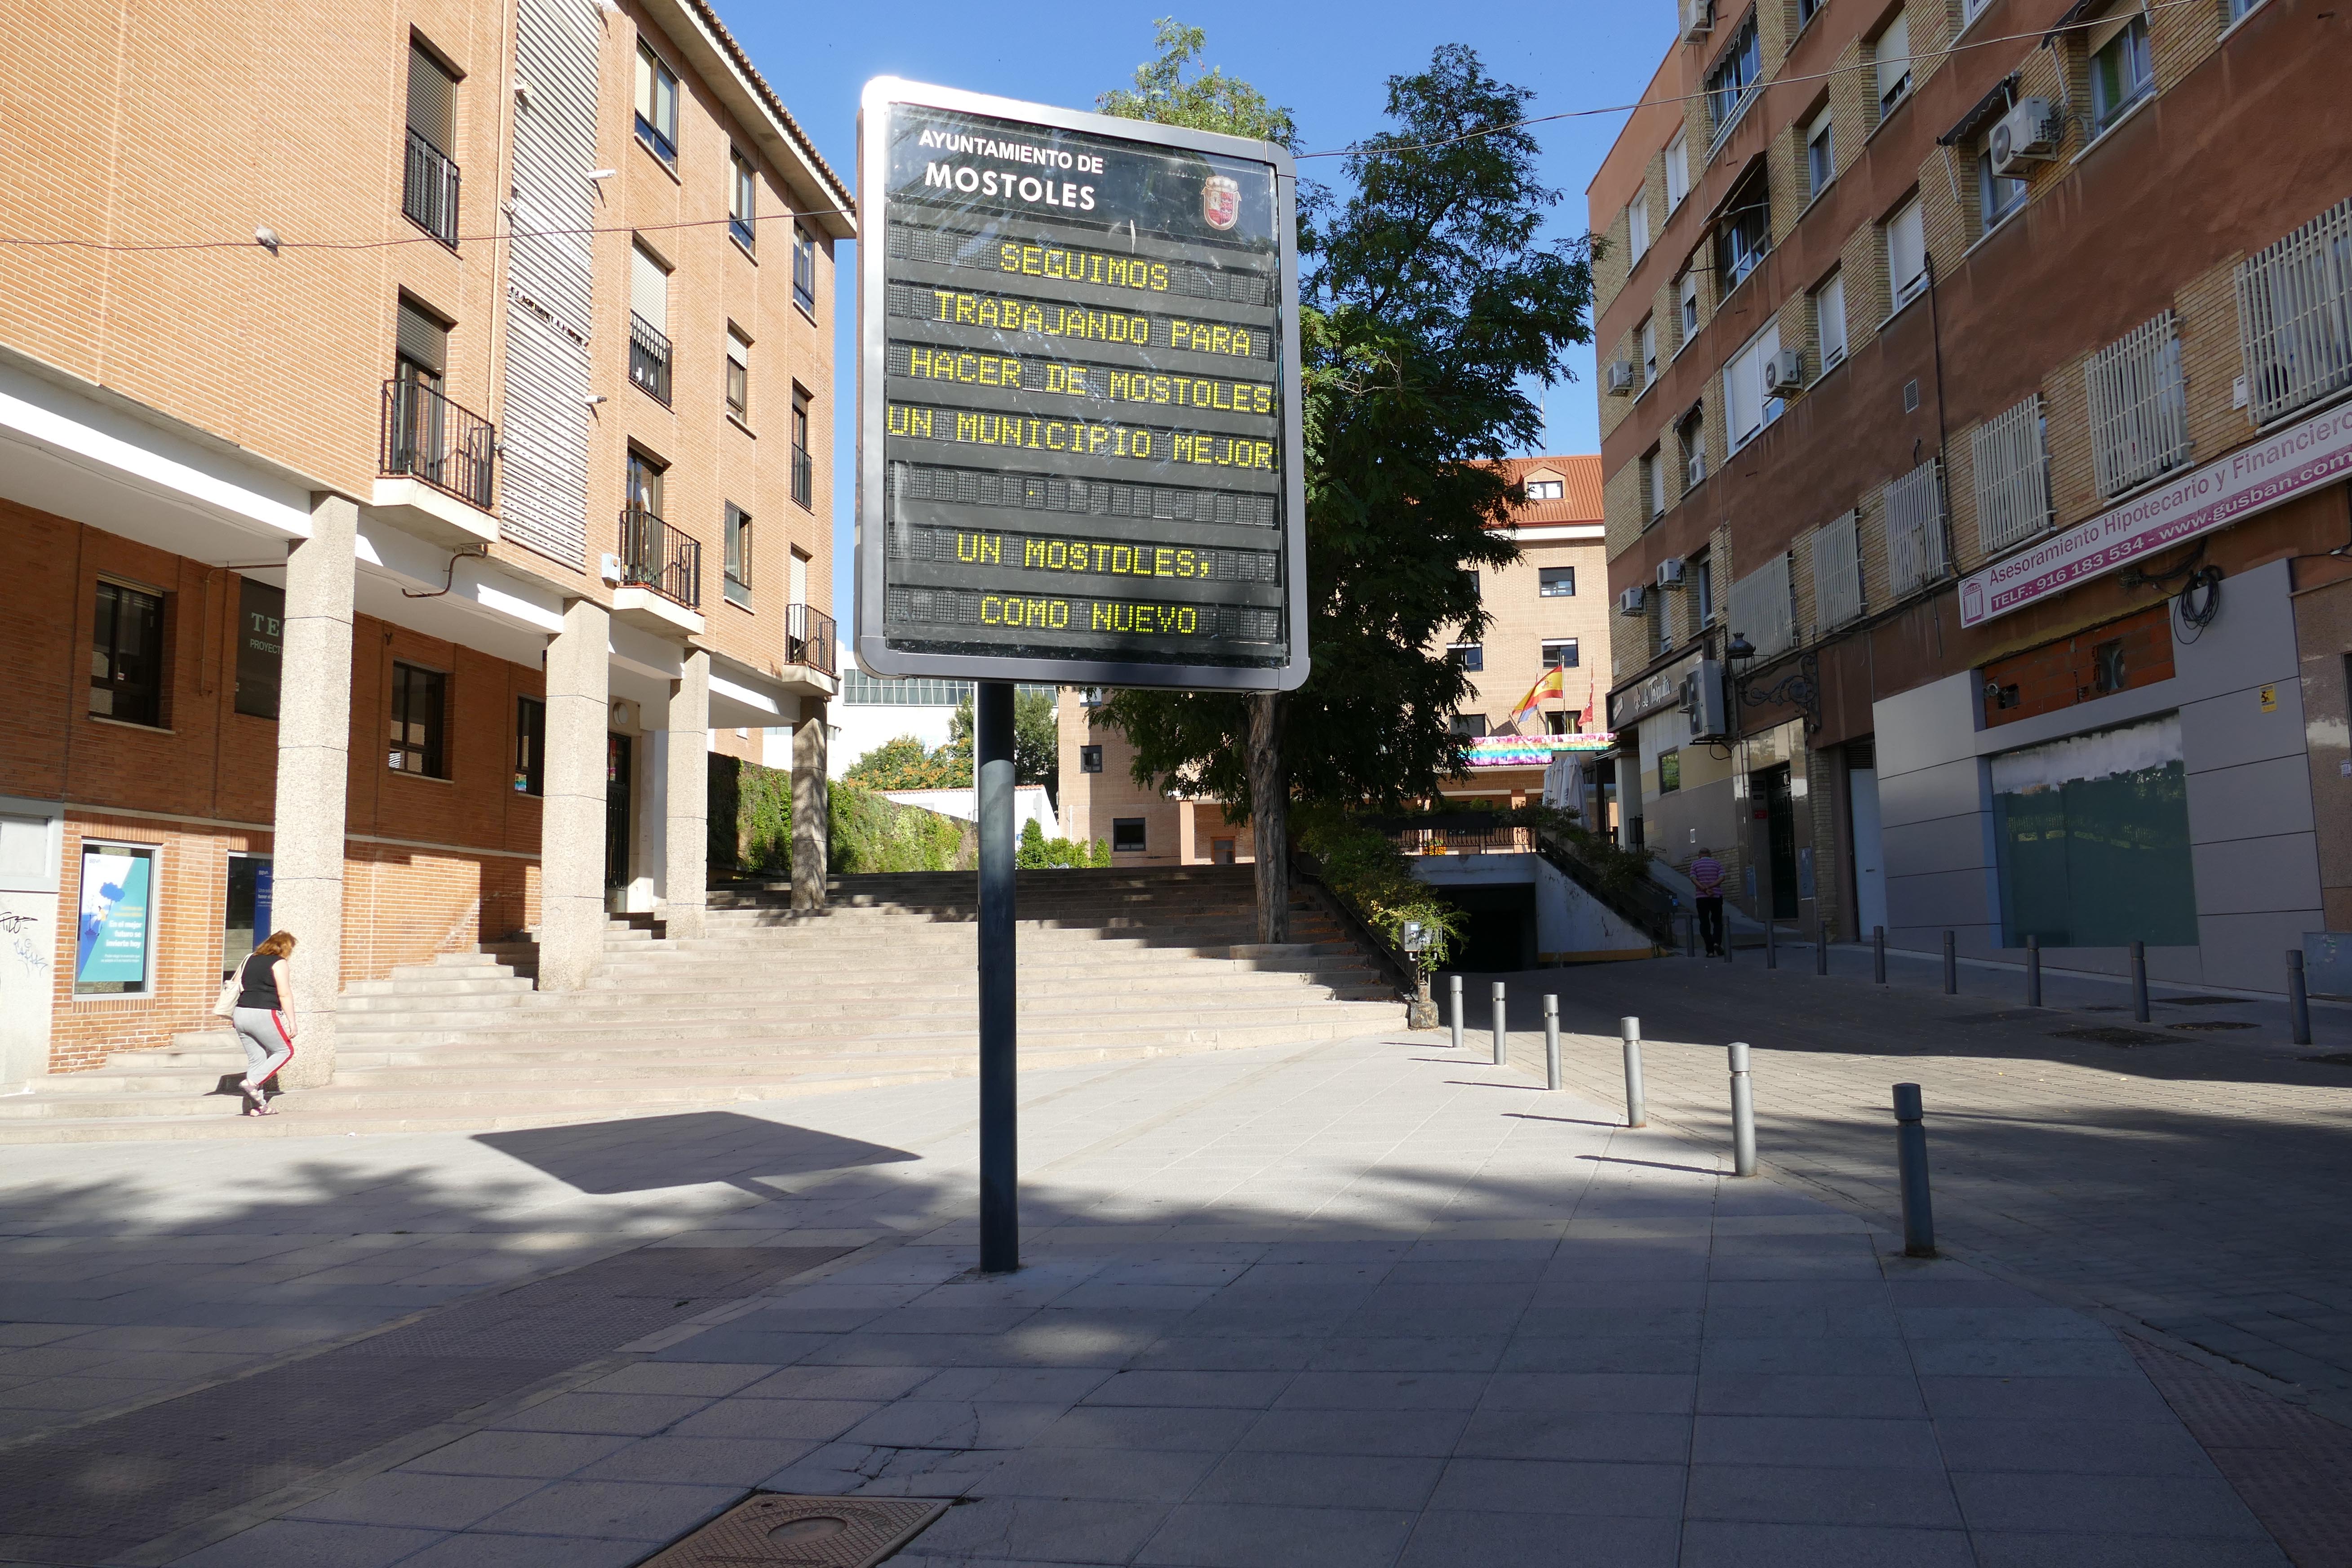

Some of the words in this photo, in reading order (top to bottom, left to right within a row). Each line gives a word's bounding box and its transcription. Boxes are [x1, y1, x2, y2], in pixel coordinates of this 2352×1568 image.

[919, 129, 1072, 169] AYUNTAMIENTO
[1078, 155, 1103, 174] DE
[925, 162, 1095, 210] MOSTOLES
[1000, 243, 1168, 292] SEGUIMOS
[934, 291, 1149, 344] TRABAJANDO
[1171, 320, 1251, 356] PARA
[910, 347, 1021, 388] HACER
[1046, 364, 1087, 395] DE
[1111, 370, 1272, 413] MOSTOLES
[887, 405, 932, 438] UN
[957, 412, 1152, 458] MUNICIPIO
[1173, 434, 1273, 468] MEJOR
[1989, 525, 2099, 586] Asesoramiento
[2104, 477, 2209, 536] Hipotecario
[2214, 469, 2226, 492] y
[958, 533, 1001, 564] UN
[1025, 539, 1209, 577] MOSTOLES,
[1993, 586, 2032, 610] TELF.:
[2037, 570, 2067, 591] 916
[2071, 554, 2103, 576] 183
[2108, 537, 2144, 560] 534
[1962, 584, 1982, 596] GUSBAN
[981, 596, 1069, 628] COMO
[1092, 602, 1197, 634] NUEVO
[124, 921, 142, 929] mejor
